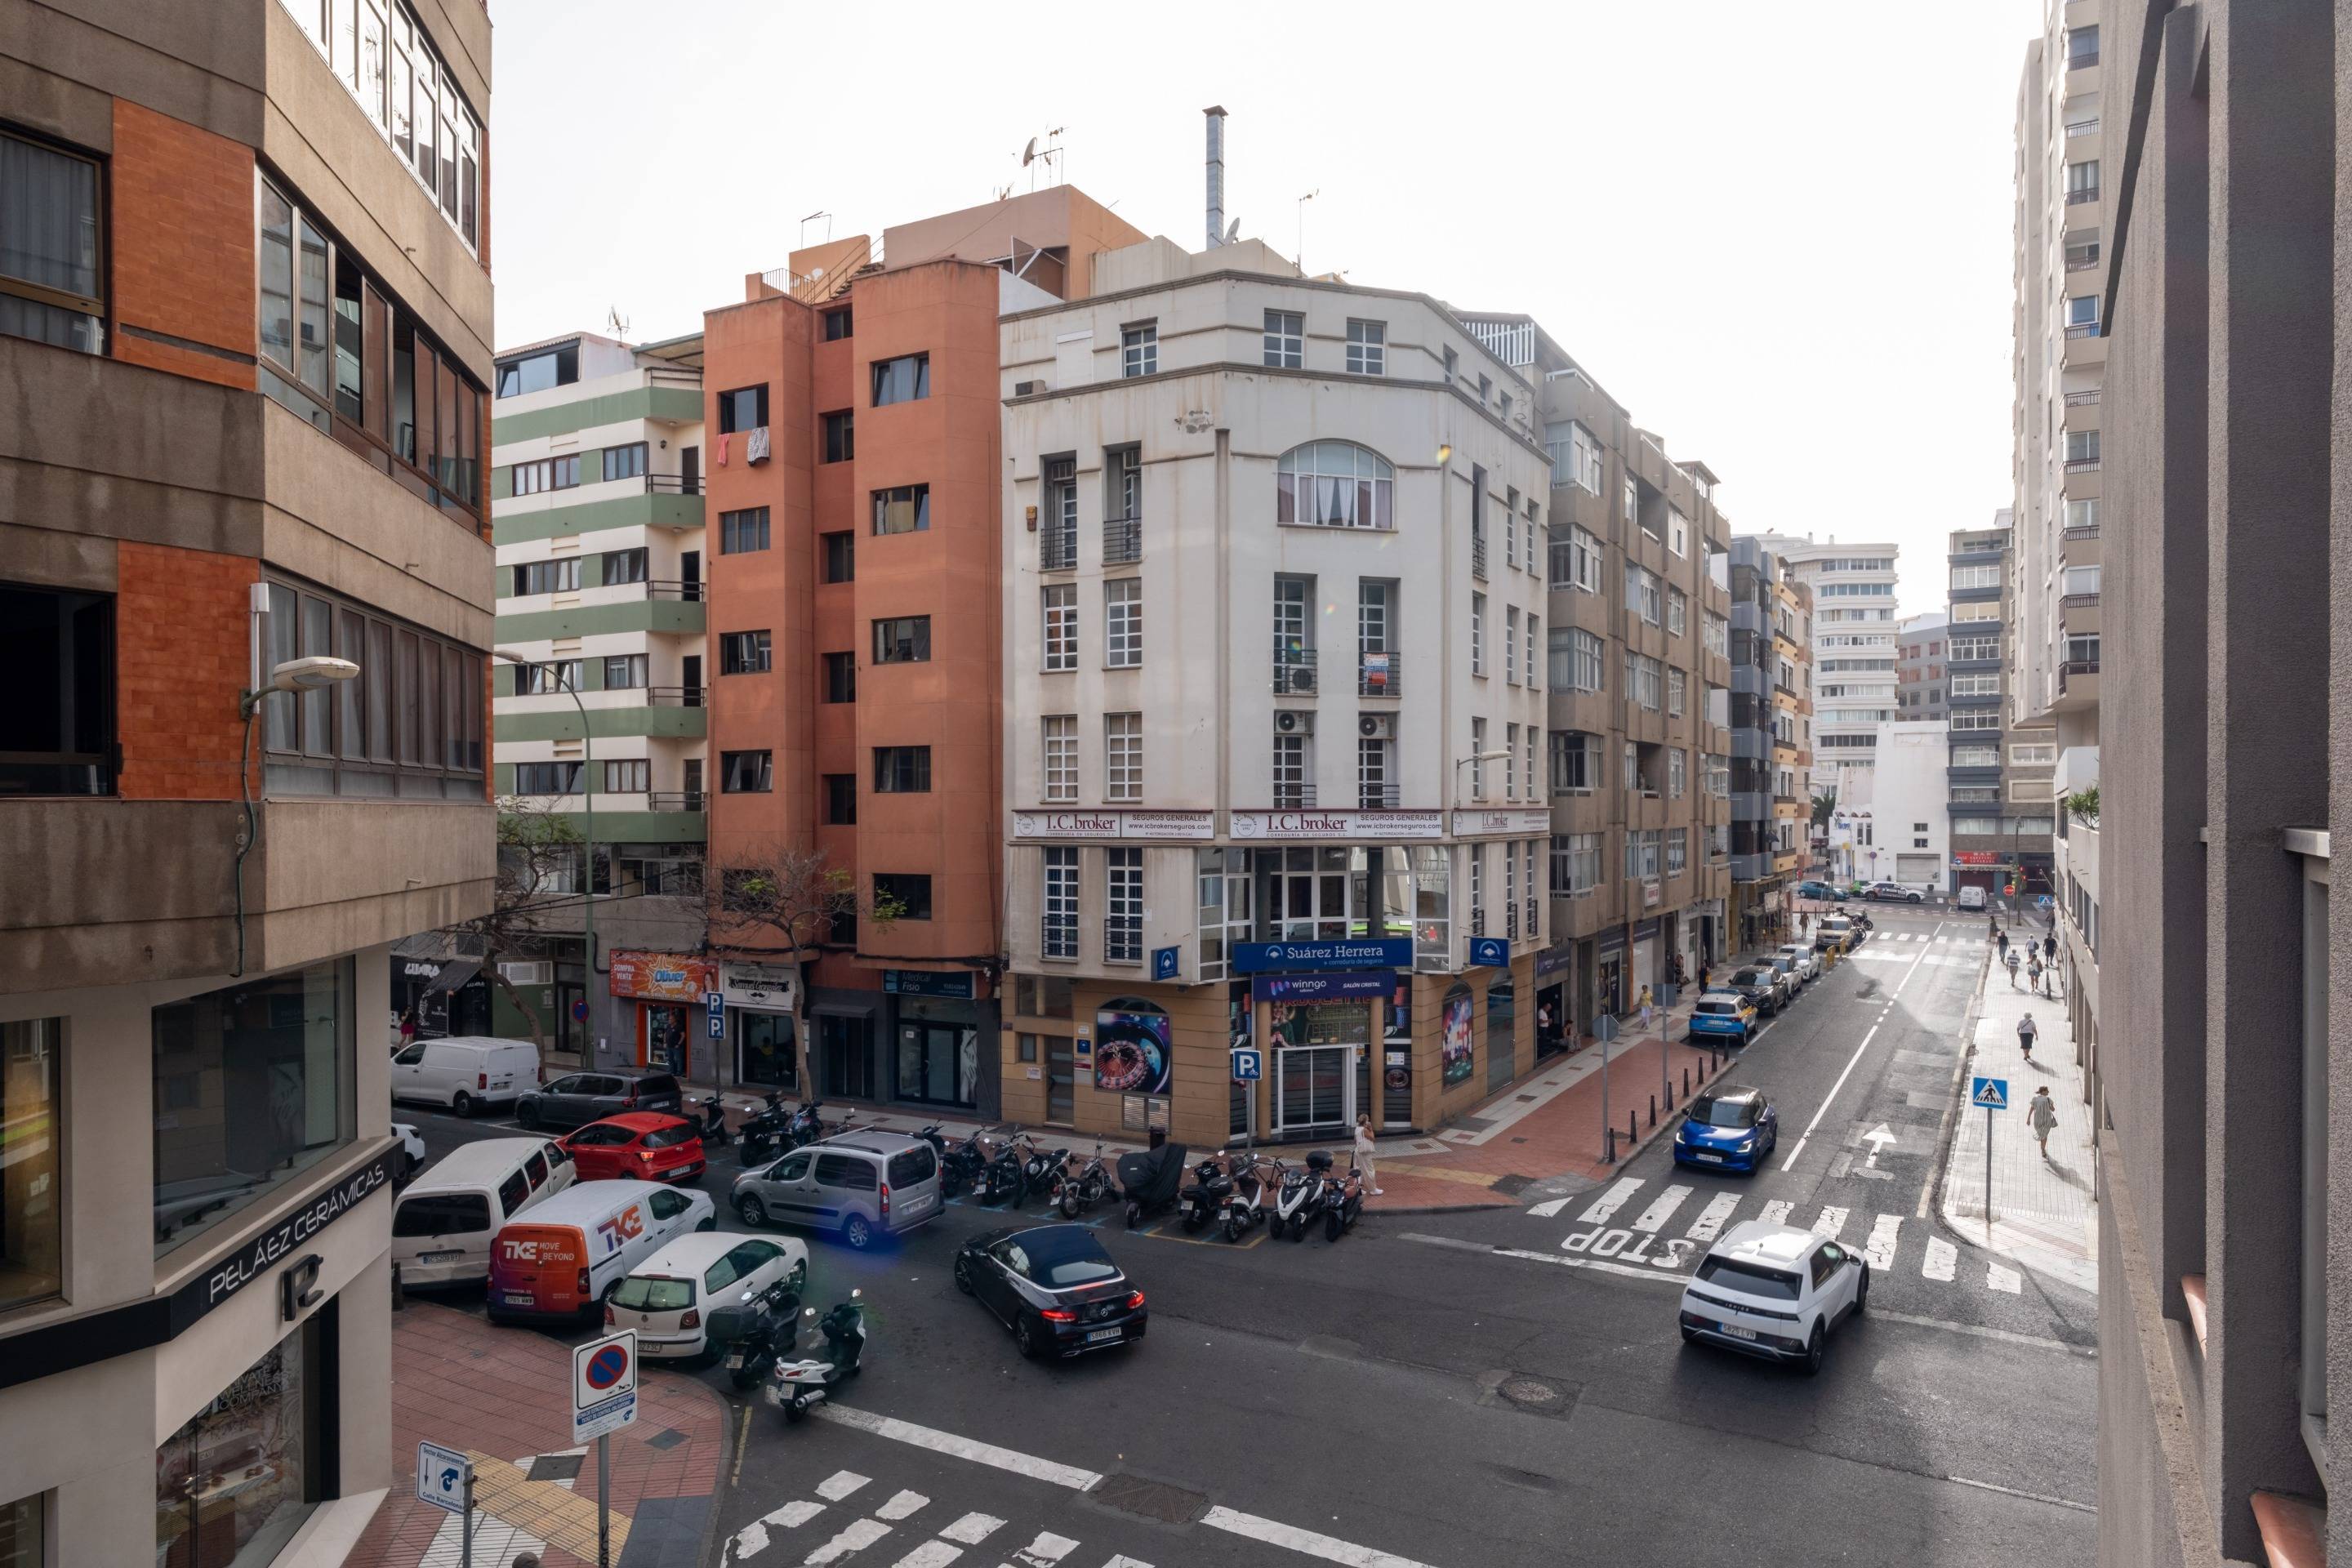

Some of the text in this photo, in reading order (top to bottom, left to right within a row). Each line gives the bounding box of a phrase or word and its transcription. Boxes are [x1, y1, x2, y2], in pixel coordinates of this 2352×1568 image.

[1128, 822, 1211, 831] www.icbrokerseguros.com
[1356, 822, 1441, 831] www.icbrokerseguros.com
[1287, 946, 1383, 959] Suárez Herrera
[613, 964, 635, 973] COMPRA
[617, 972, 634, 981] VENTA
[654, 969, 685, 982] Oliver
[902, 981, 920, 991] Fisio
[1292, 979, 1327, 990] winngo
[710, 995, 720, 1011] P
[710, 1018, 721, 1036] P
[1239, 1054, 1254, 1076] P
[210, 1163, 385, 1303] PELÁEZ CERÁMICAS
[597, 1205, 644, 1253] TKE
[503, 1241, 560, 1260] TKE MOVE
[1561, 1226, 1695, 1268] STOP
[543, 1252, 575, 1261] BEYOND
[1091, 1330, 1107, 1340] 5866
[423, 1447, 436, 1457] Sector
[422, 1491, 463, 1510] Calle Barcelona
